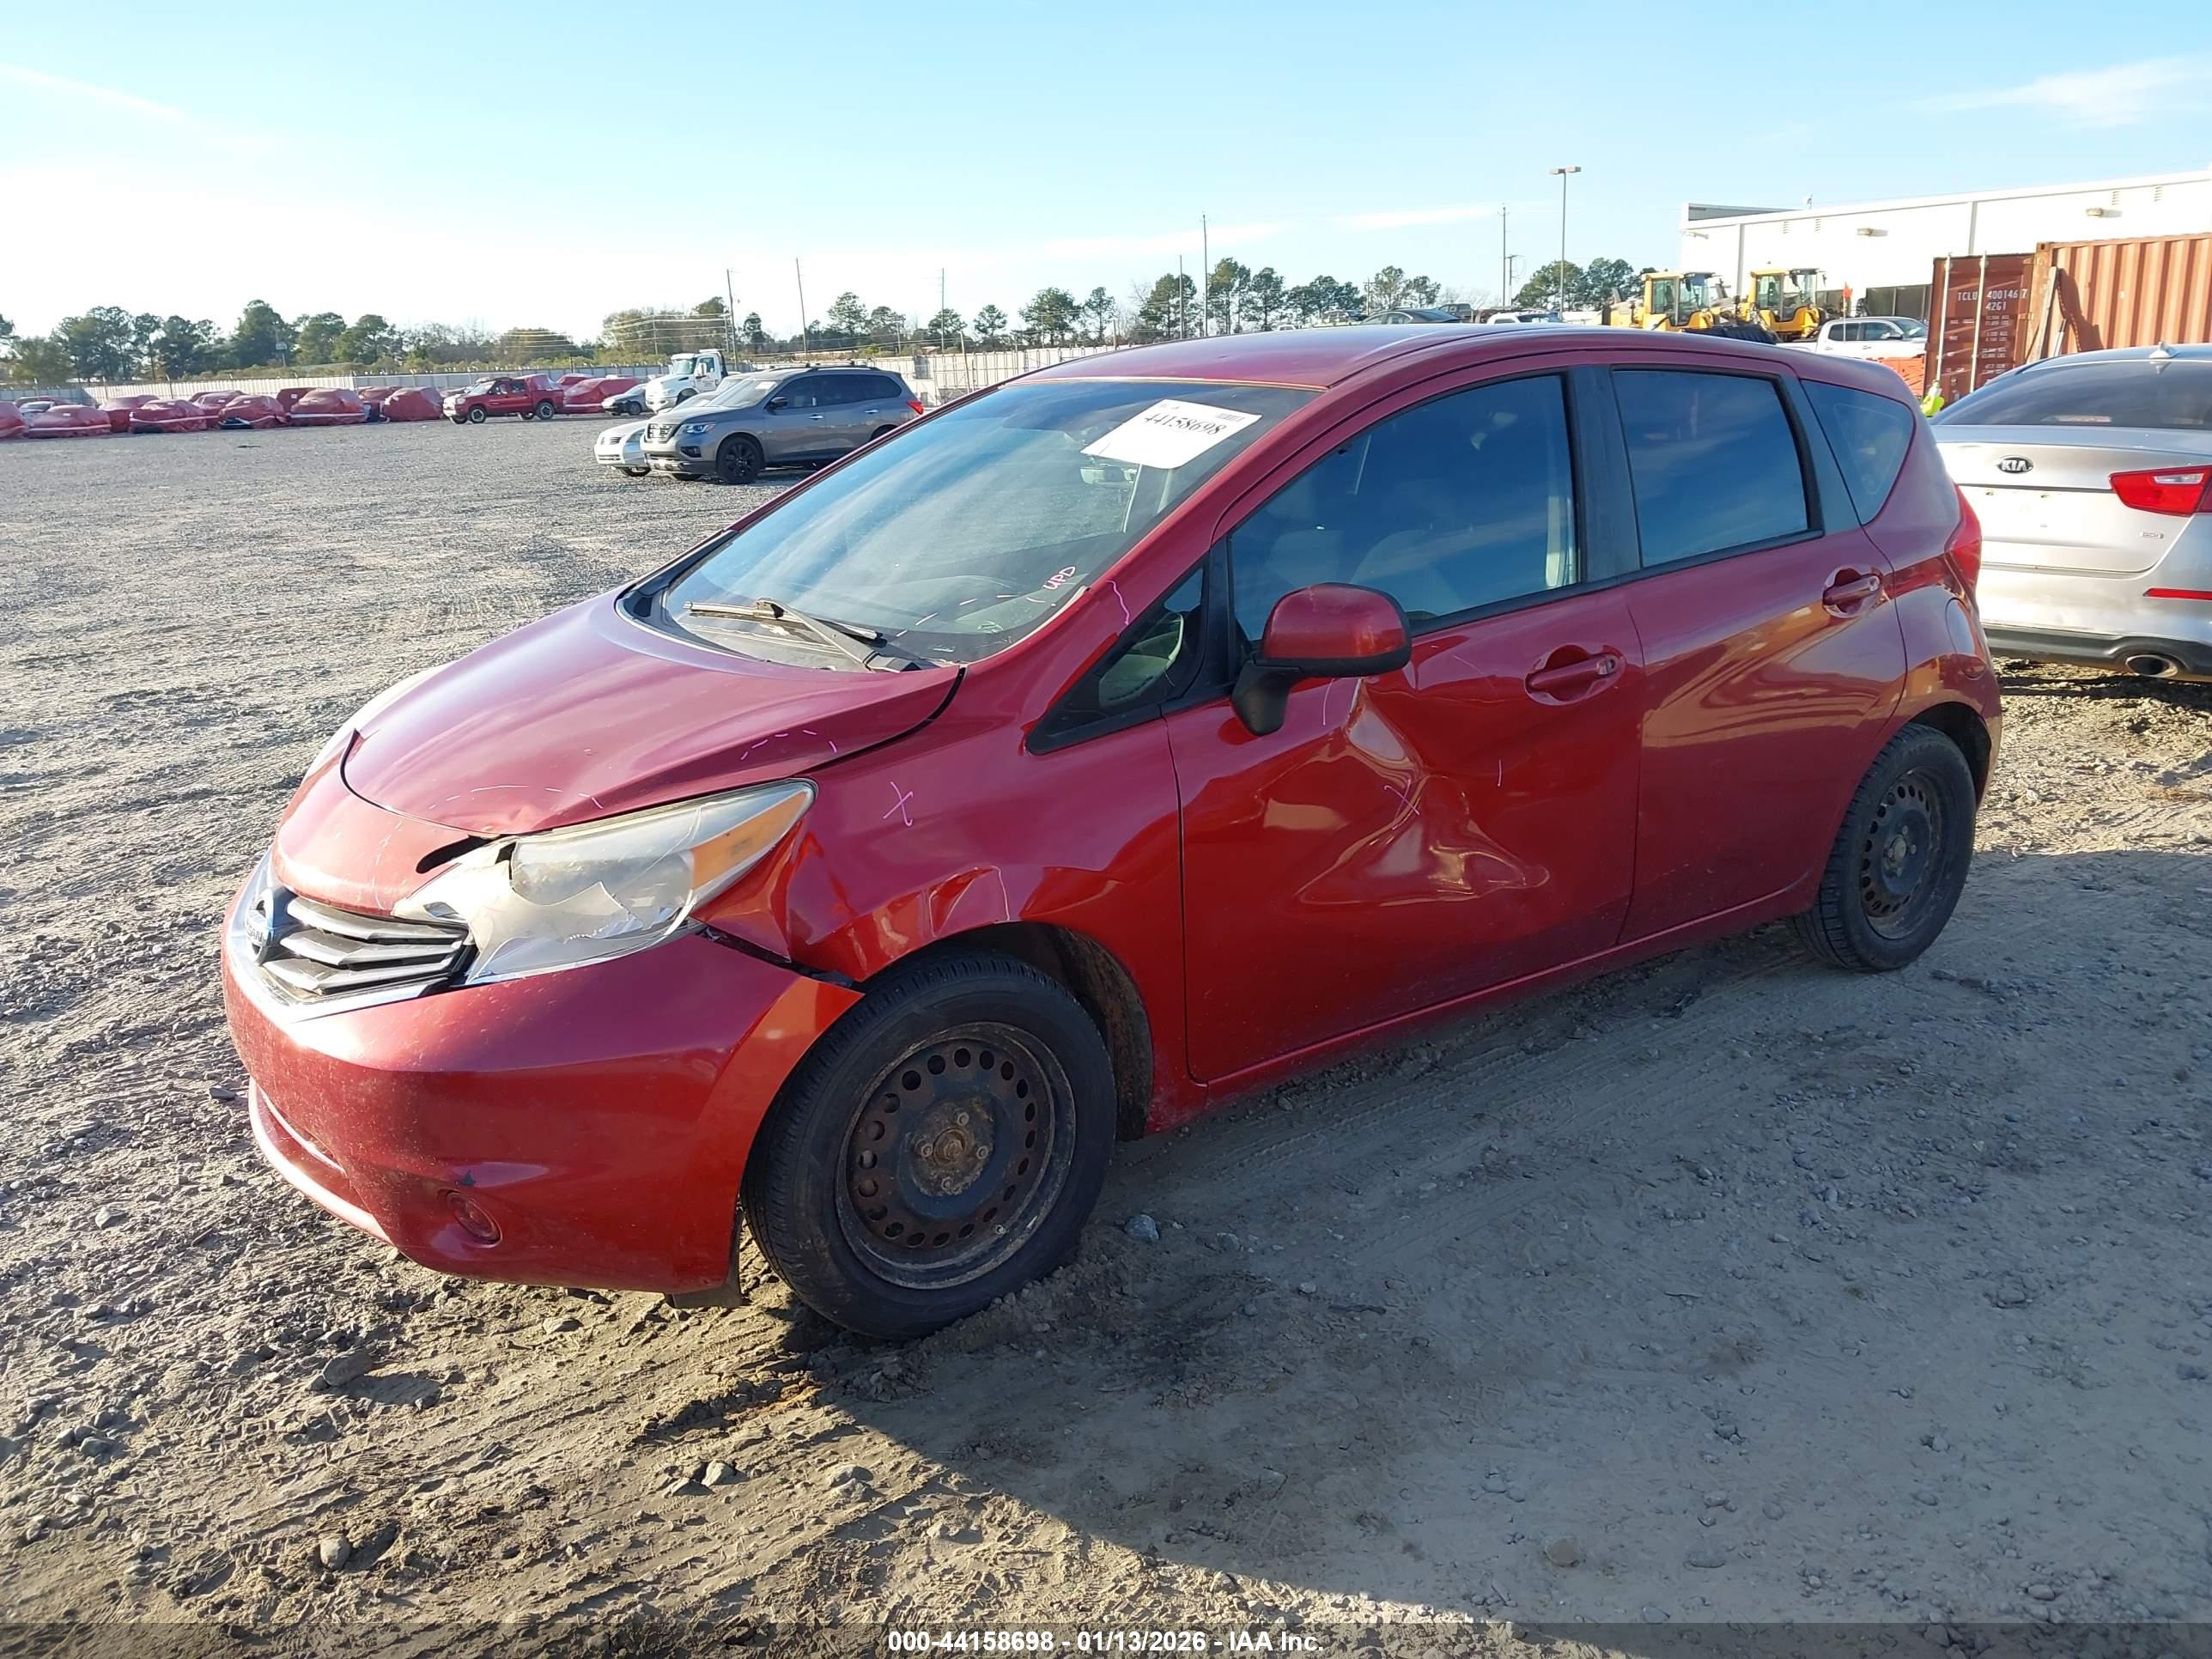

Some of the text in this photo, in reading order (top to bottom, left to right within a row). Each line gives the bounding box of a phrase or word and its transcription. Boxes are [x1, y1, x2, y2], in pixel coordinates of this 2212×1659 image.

[1985, 302, 2007, 311] 42G1
[1144, 412, 1228, 435] 44158698
[1999, 459, 2029, 471] KIA
